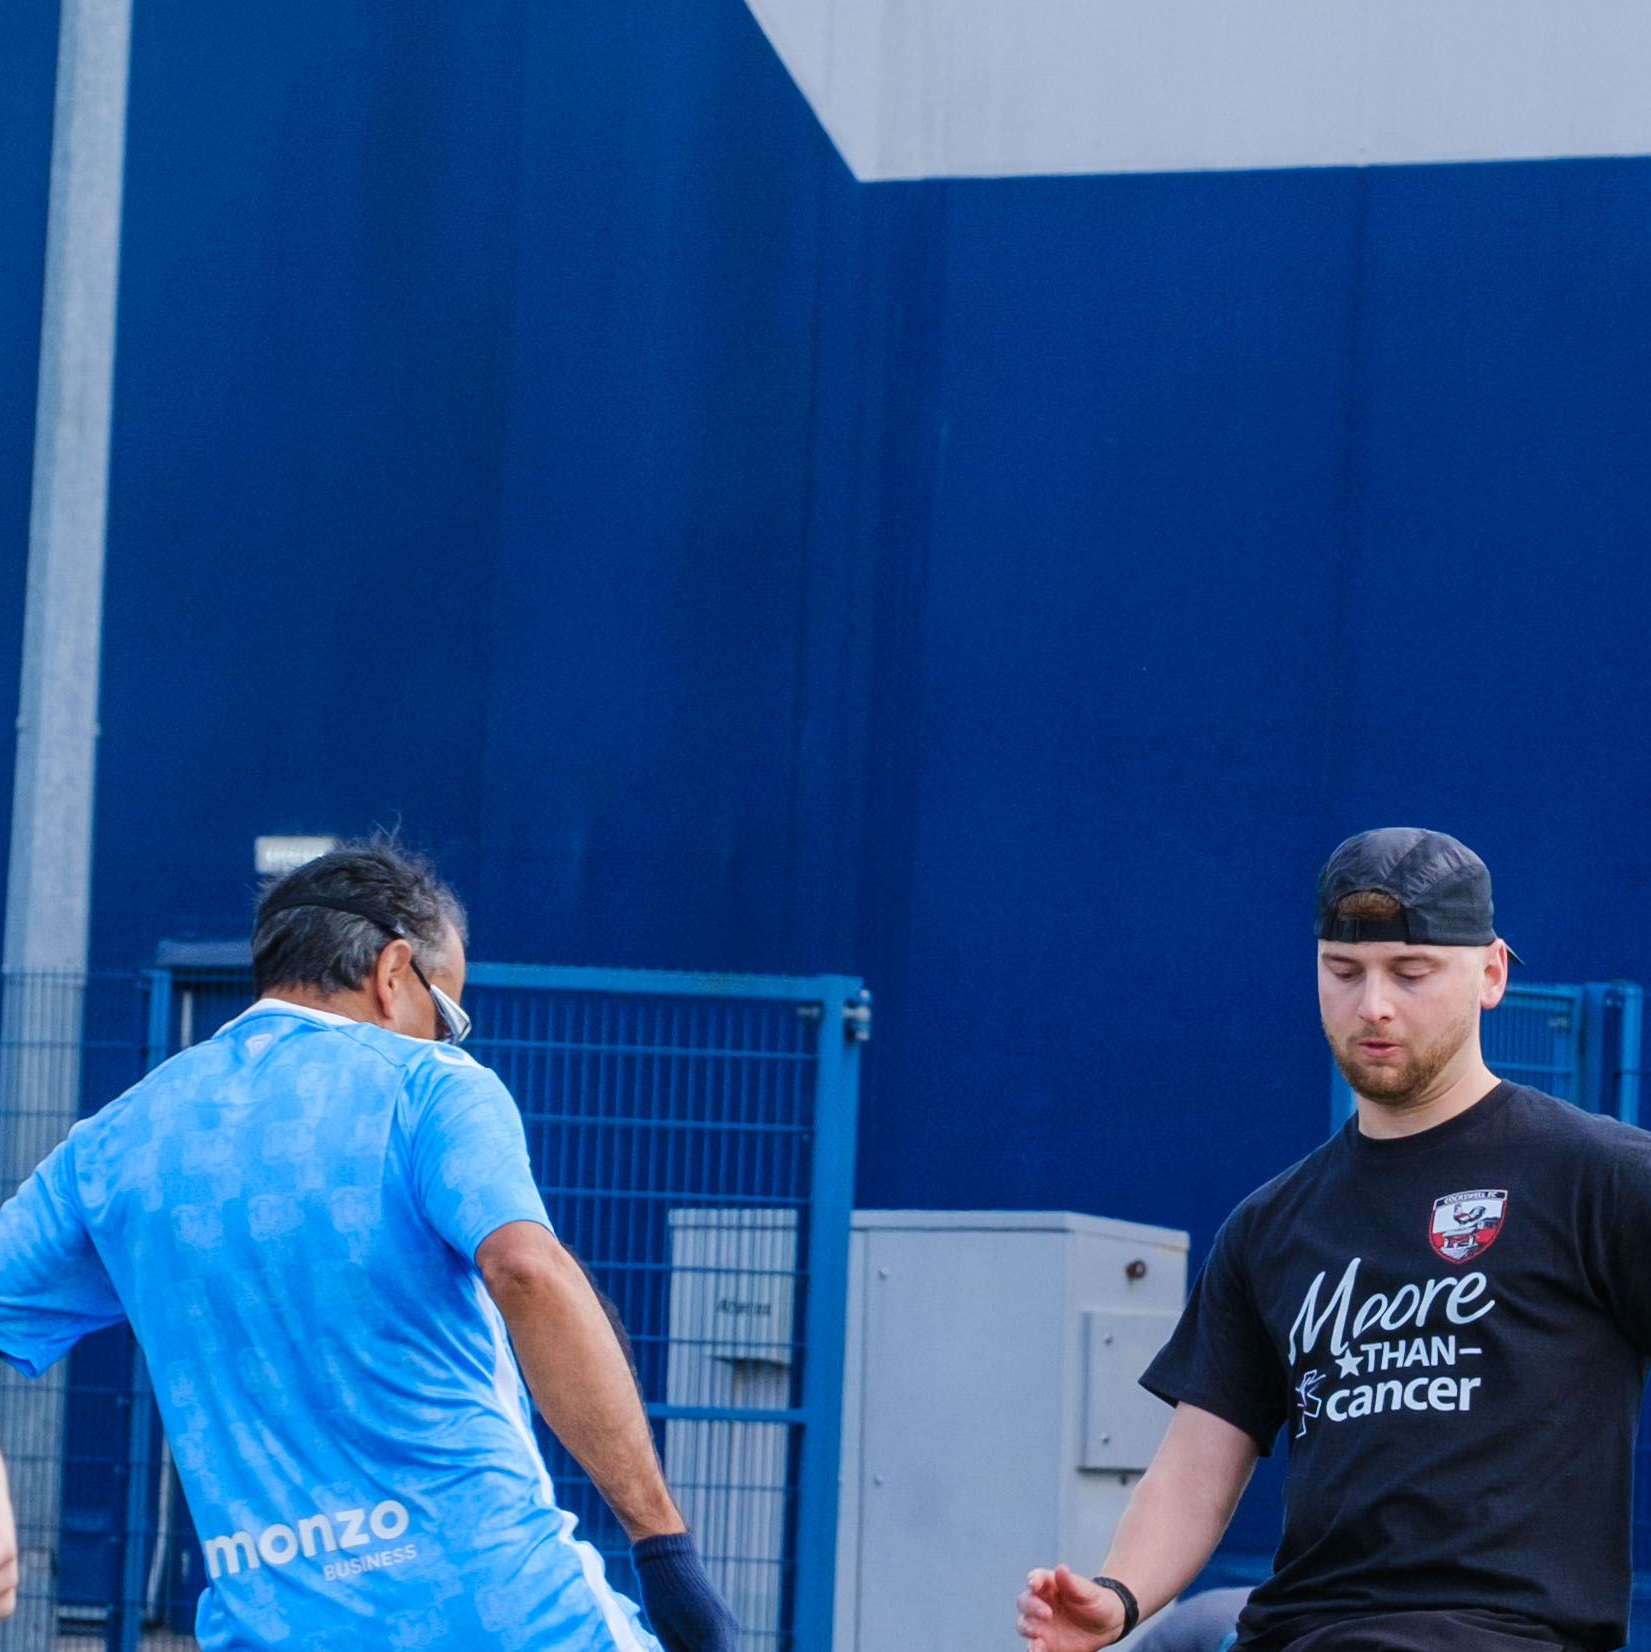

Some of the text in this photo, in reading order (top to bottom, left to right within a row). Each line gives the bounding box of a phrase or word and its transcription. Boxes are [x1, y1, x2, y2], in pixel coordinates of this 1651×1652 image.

[1288, 1257, 1496, 1367] Moore
[1326, 1376, 1482, 1422] cancer
[204, 1499, 410, 1580] monzo
[322, 1544, 418, 1583] BUSINESS
